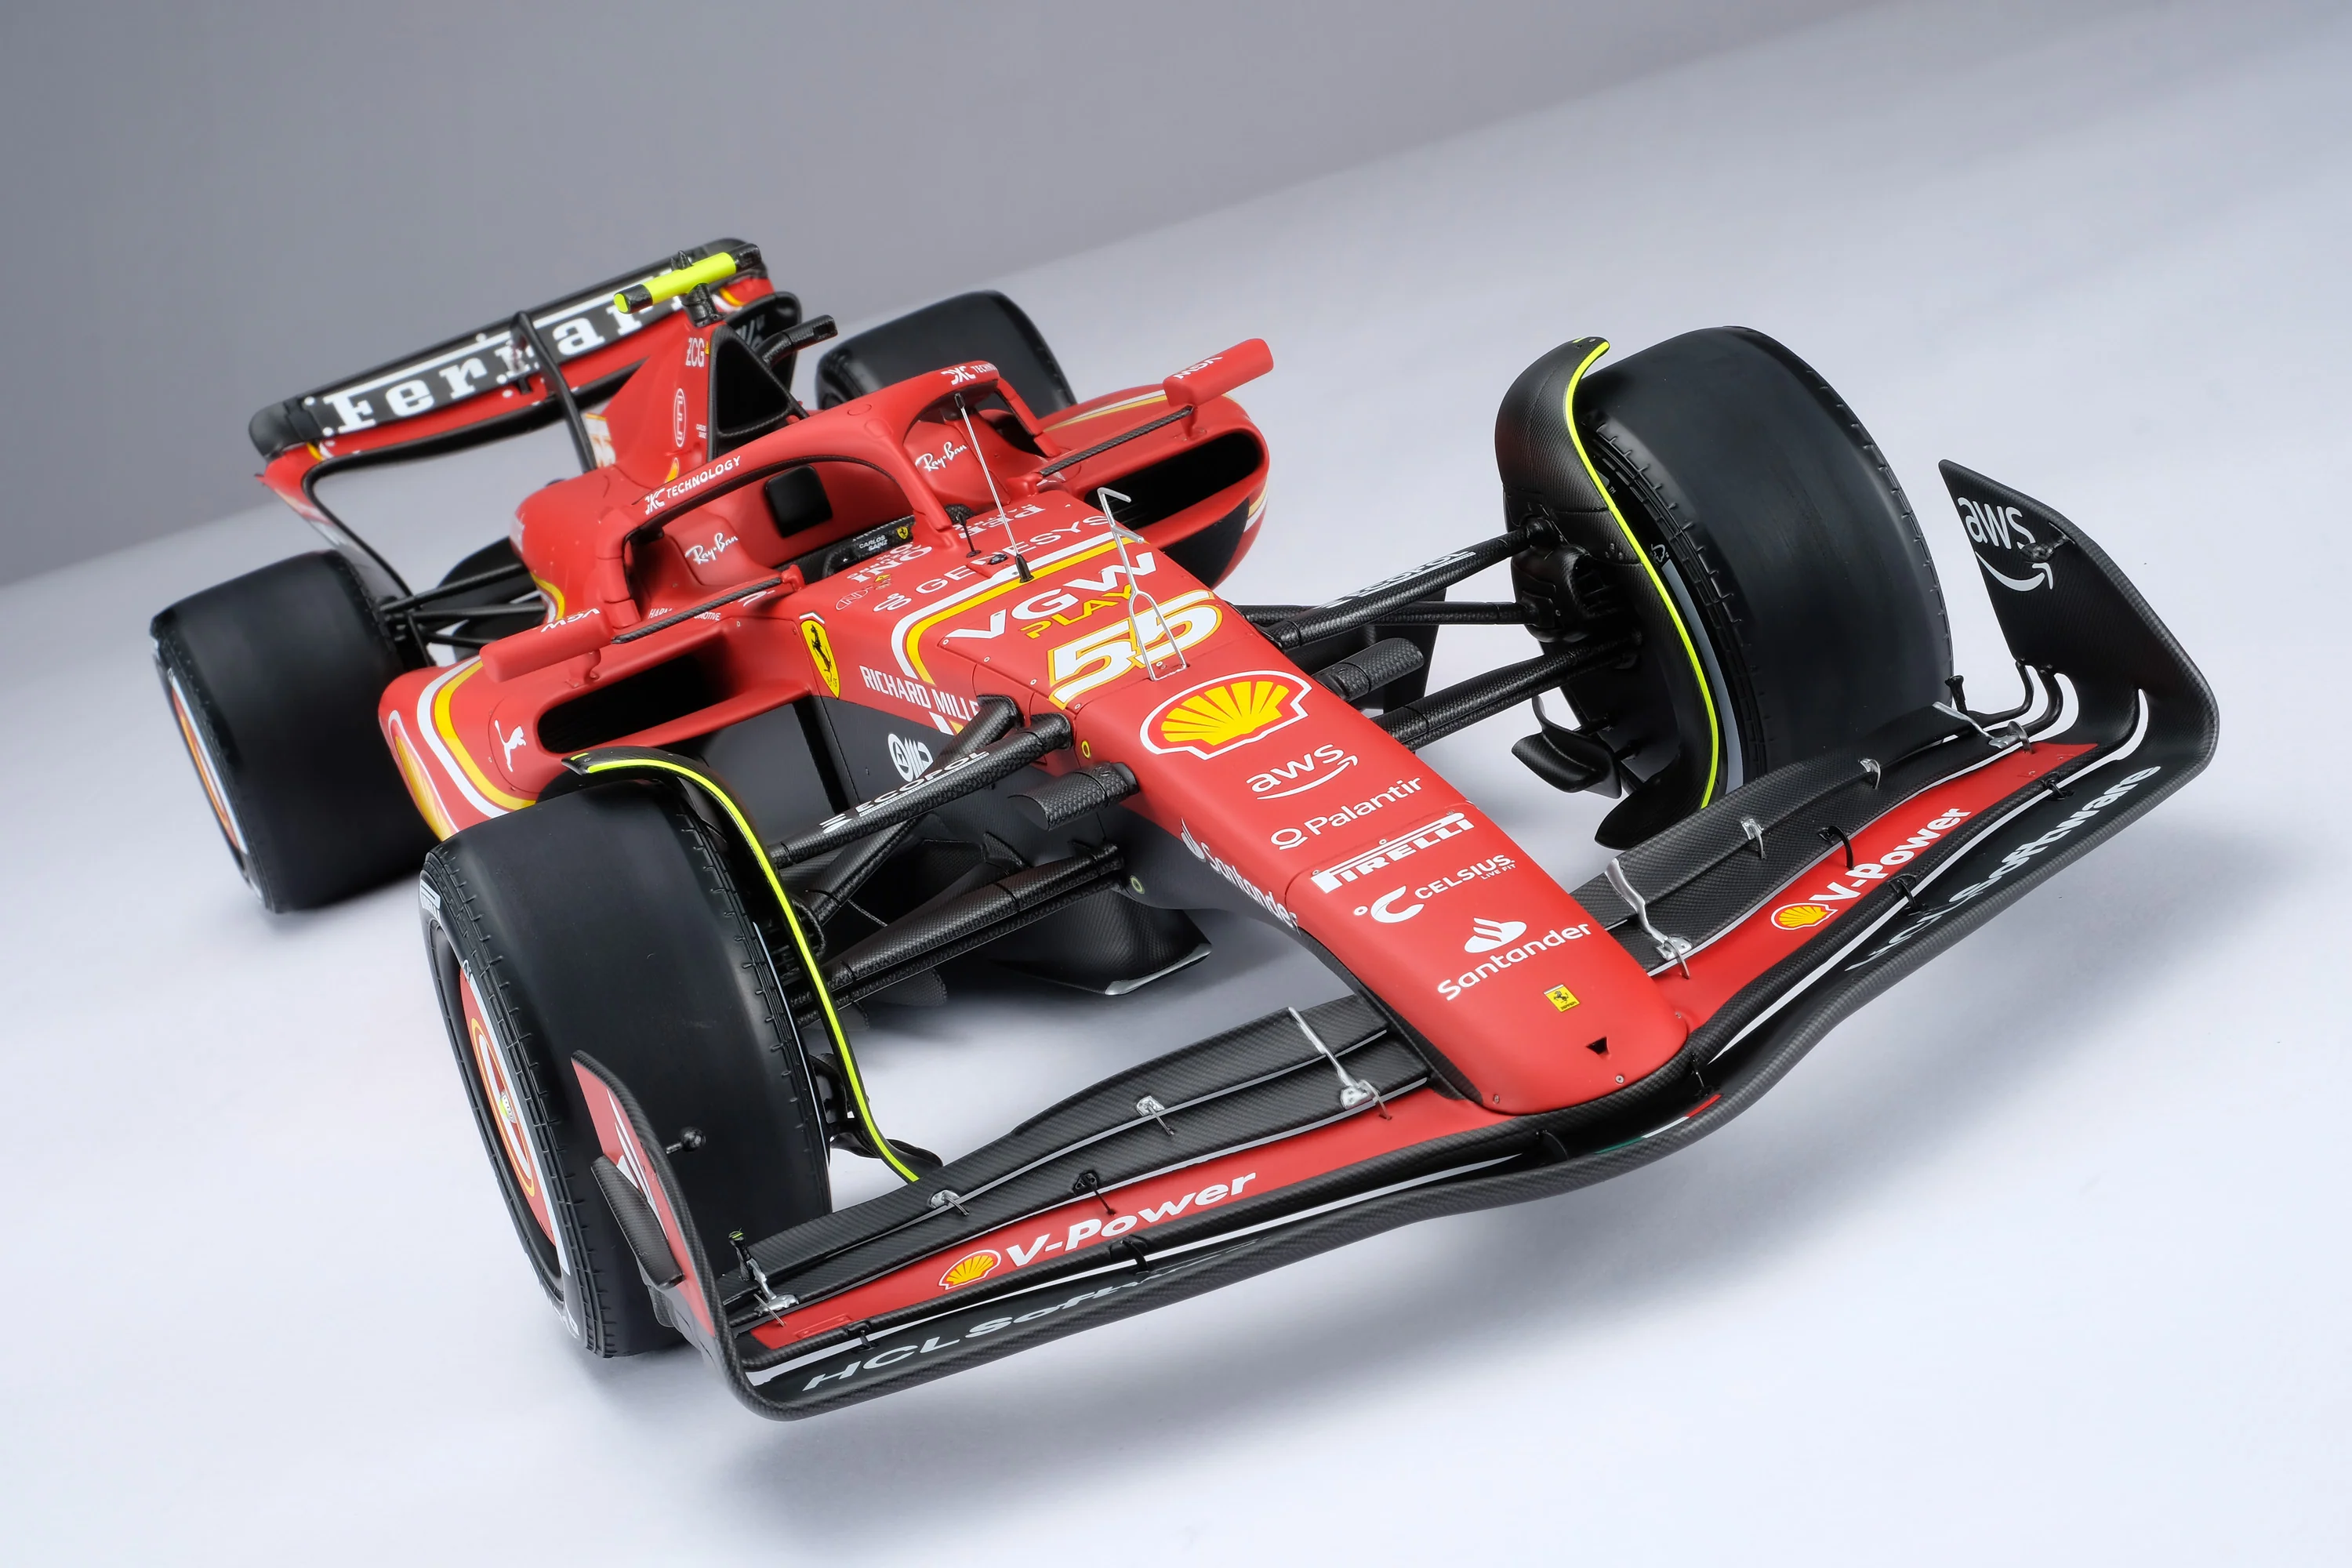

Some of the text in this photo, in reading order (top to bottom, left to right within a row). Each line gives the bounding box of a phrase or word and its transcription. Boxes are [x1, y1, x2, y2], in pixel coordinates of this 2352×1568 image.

[685, 337, 705, 368] ZCG
[666, 455, 741, 499] TECHNOLOGY
[914, 441, 967, 472] Ray-Ban
[684, 532, 739, 564] Ray-Ban
[858, 535, 886, 550] CARLOS
[868, 539, 888, 552] SAINZ
[1957, 496, 2035, 550] aws
[944, 551, 1158, 640] VGW
[1019, 587, 1136, 640] PLAY
[1047, 588, 1222, 710] 55
[858, 665, 932, 709] RICHARD
[855, 750, 989, 812] ECOPOL
[1246, 743, 1345, 794] aws
[1304, 775, 1422, 836] Palantir
[1310, 812, 1475, 894] PIRELLI
[1480, 863, 1516, 880] LIVE FIT
[1808, 807, 1973, 902] V-Power
[1200, 841, 1301, 936] Santander
[1436, 921, 1593, 1001] Santander
[1005, 1171, 1257, 1268] V-Power
[801, 1336, 961, 1392] HCL
